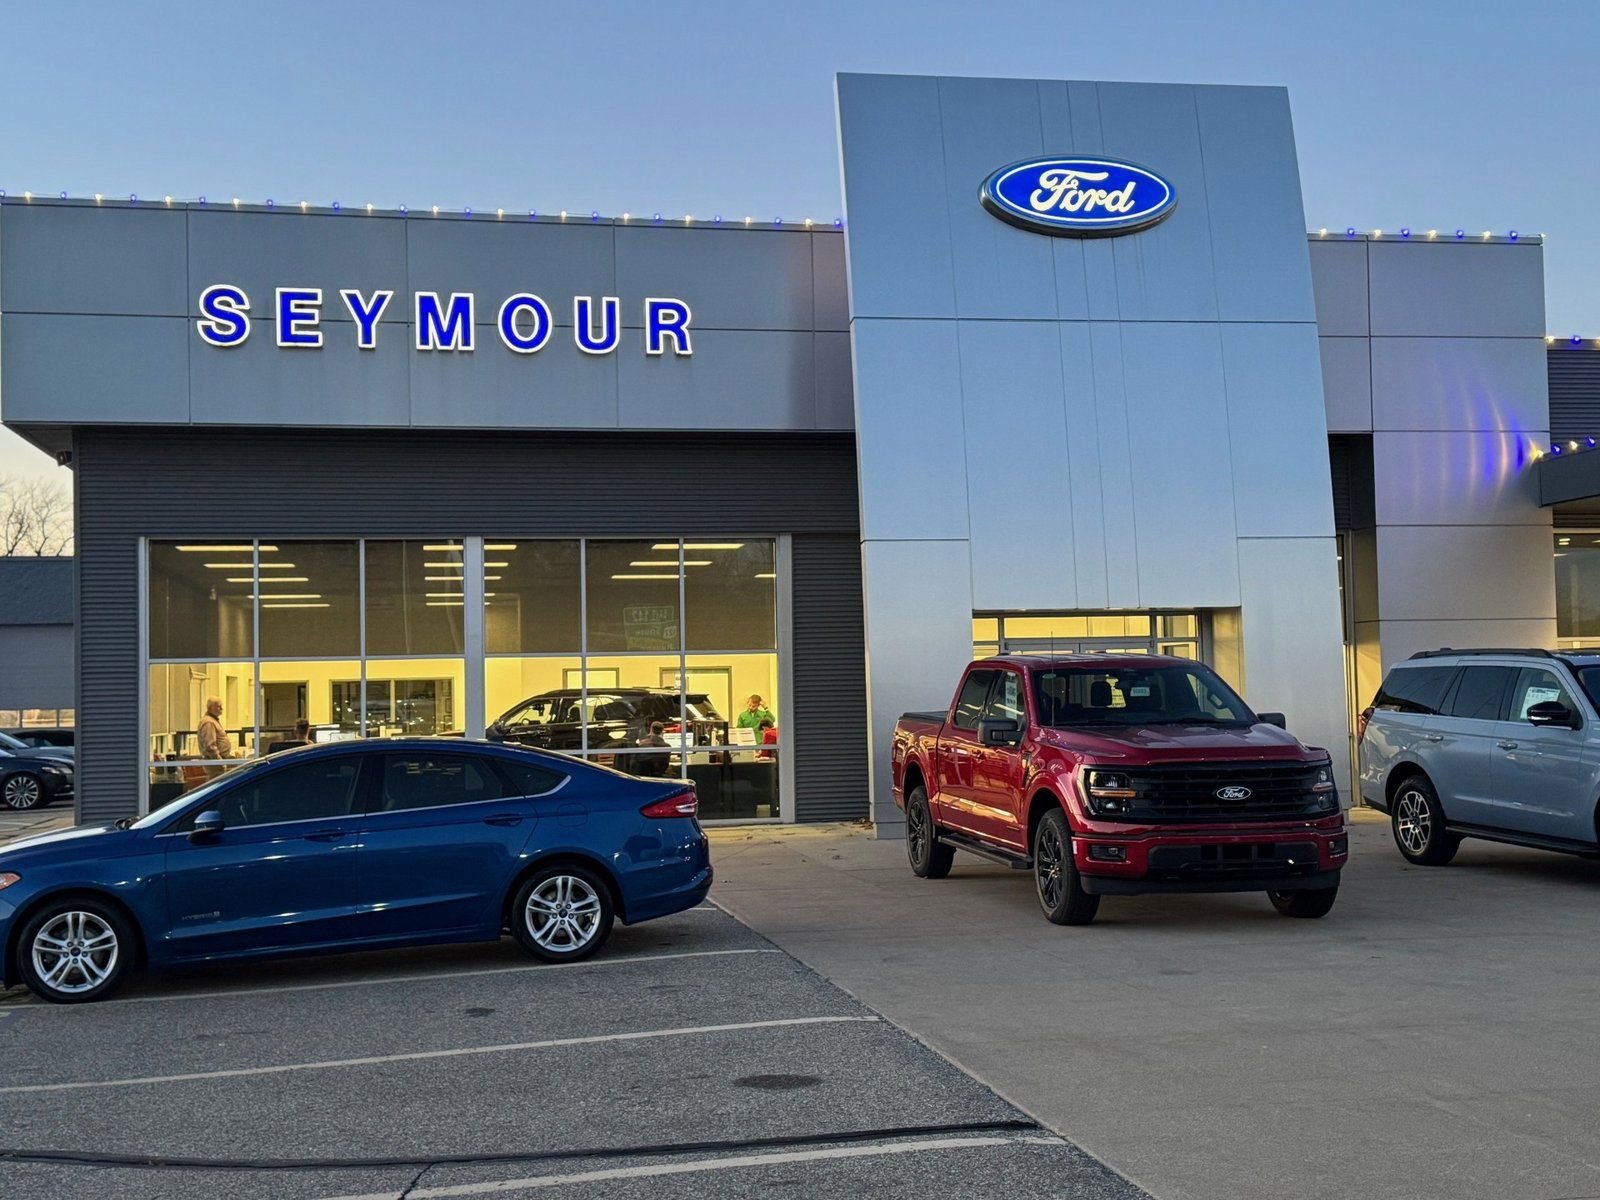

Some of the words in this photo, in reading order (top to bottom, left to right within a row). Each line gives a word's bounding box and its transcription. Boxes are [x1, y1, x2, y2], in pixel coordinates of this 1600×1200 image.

[1030, 169, 1136, 213] Ford
[197, 284, 693, 355] SEYMOUR
[1222, 787, 1244, 797] Ford
